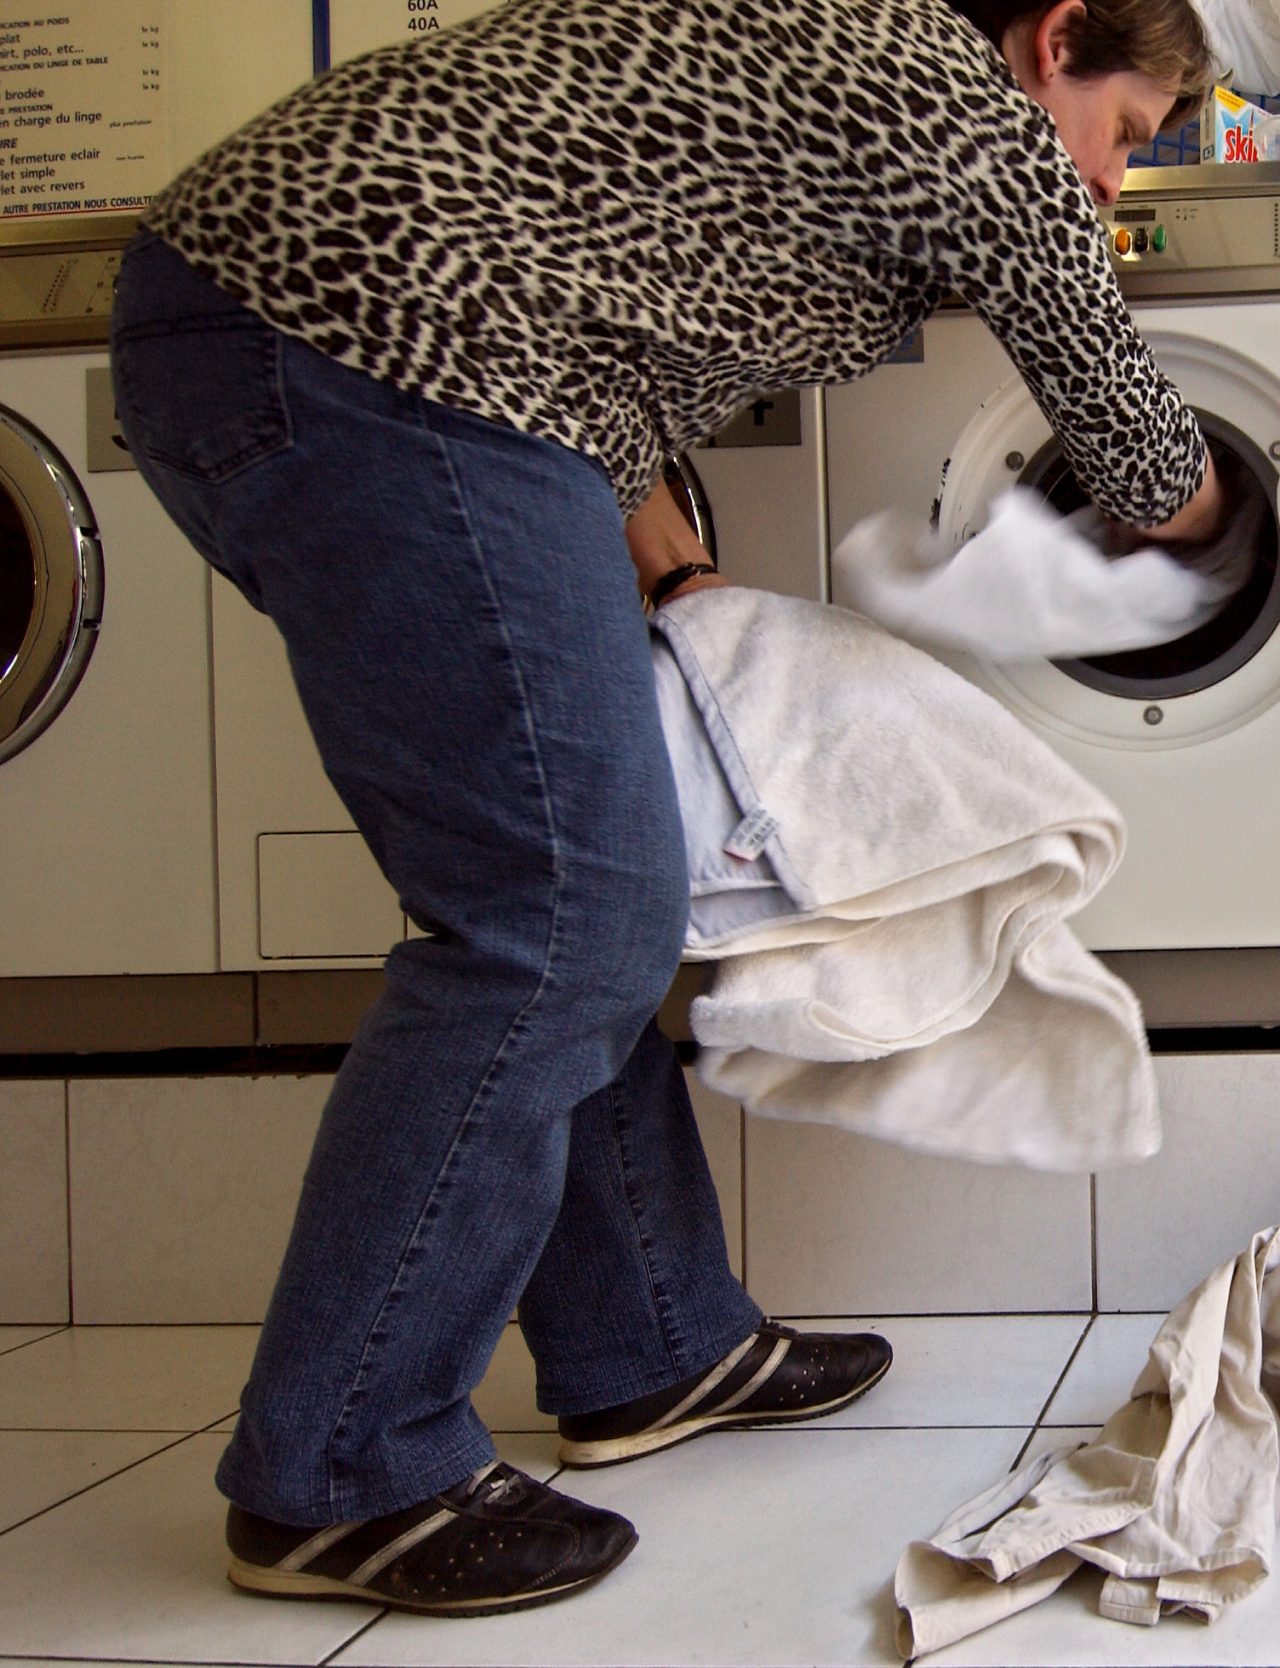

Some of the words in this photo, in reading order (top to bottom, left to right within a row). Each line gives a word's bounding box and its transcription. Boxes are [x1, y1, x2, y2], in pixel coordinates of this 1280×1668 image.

[408, 0, 438, 12] 60A
[47, 17, 69, 26] POIDS
[408, 17, 439, 31] 40A
[24, 45, 52, 60] polo,
[57, 44, 84, 54] etc...
[47, 59, 69, 68] LINGE
[72, 58, 82, 66] DE
[85, 56, 108, 65] TABLE
[8, 103, 53, 114] PRESTATION
[14, 116, 51, 128] charge
[56, 113, 70, 124] du
[75, 111, 102, 124] linge
[10, 151, 65, 165] fermeture
[70, 148, 101, 161] eclair
[0, 170, 15, 181] let
[20, 166, 55, 180] simple
[0, 185, 15, 195] let
[20, 184, 46, 194] avec
[50, 180, 85, 191] revers
[3, 204, 29, 215] AUTRE
[32, 201, 80, 213] PRESTATION
[84, 198, 107, 209] NOUS
